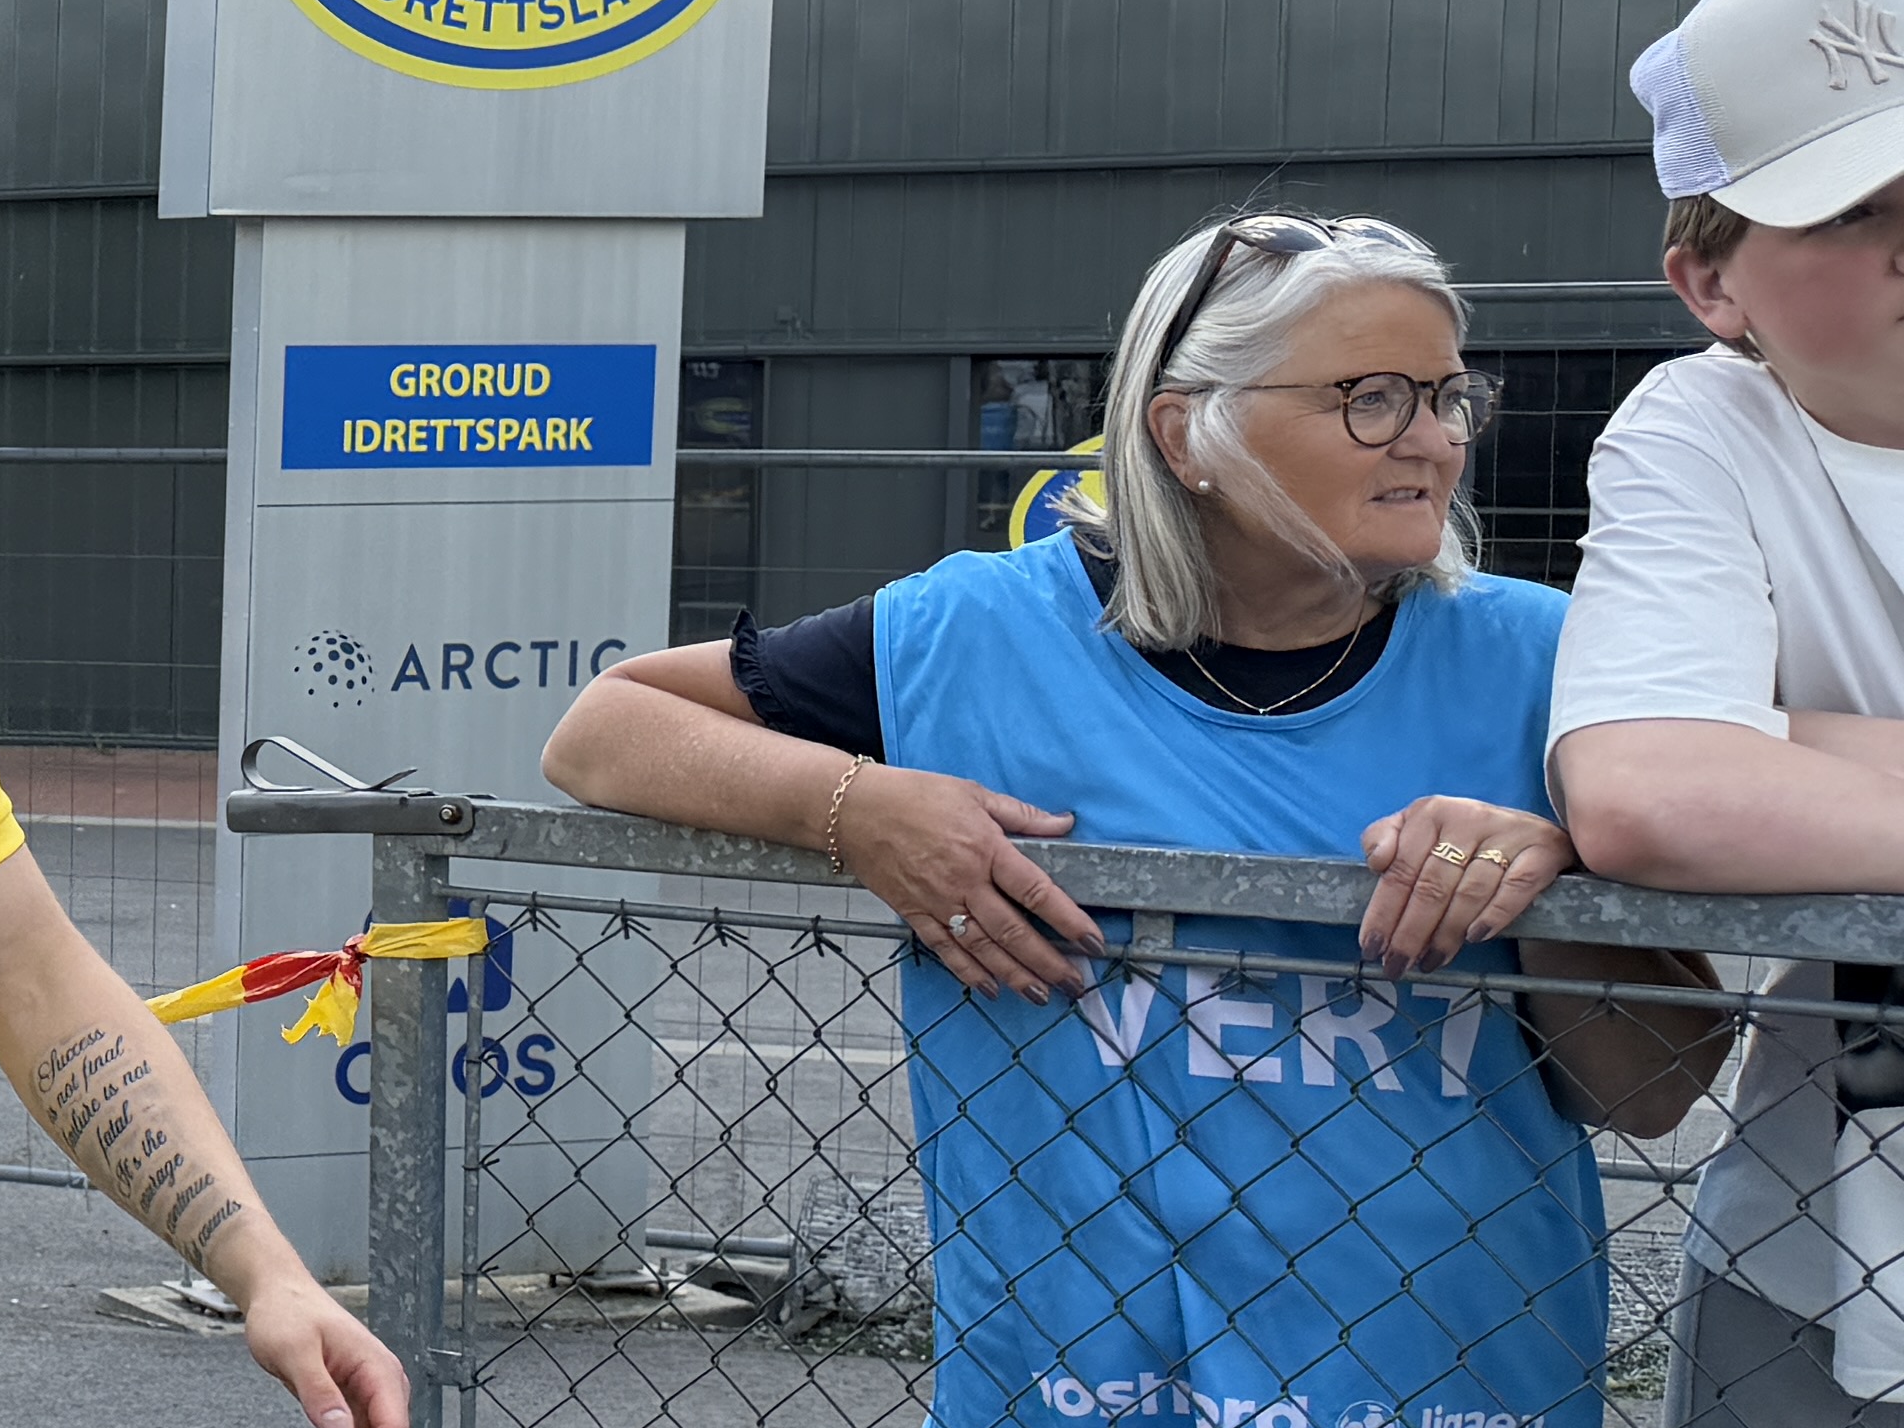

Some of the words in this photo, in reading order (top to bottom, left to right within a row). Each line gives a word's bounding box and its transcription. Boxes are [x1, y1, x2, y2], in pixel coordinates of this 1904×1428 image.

[389, 363, 551, 397] GRORUD
[342, 416, 594, 454] IDRETTSPARK
[390, 638, 627, 692] ARCTIC
[1069, 945, 1514, 1098] VERT
[81, 1034, 125, 1093] final
[335, 1033, 557, 1105] OOS
[141, 1128, 168, 1159] the
